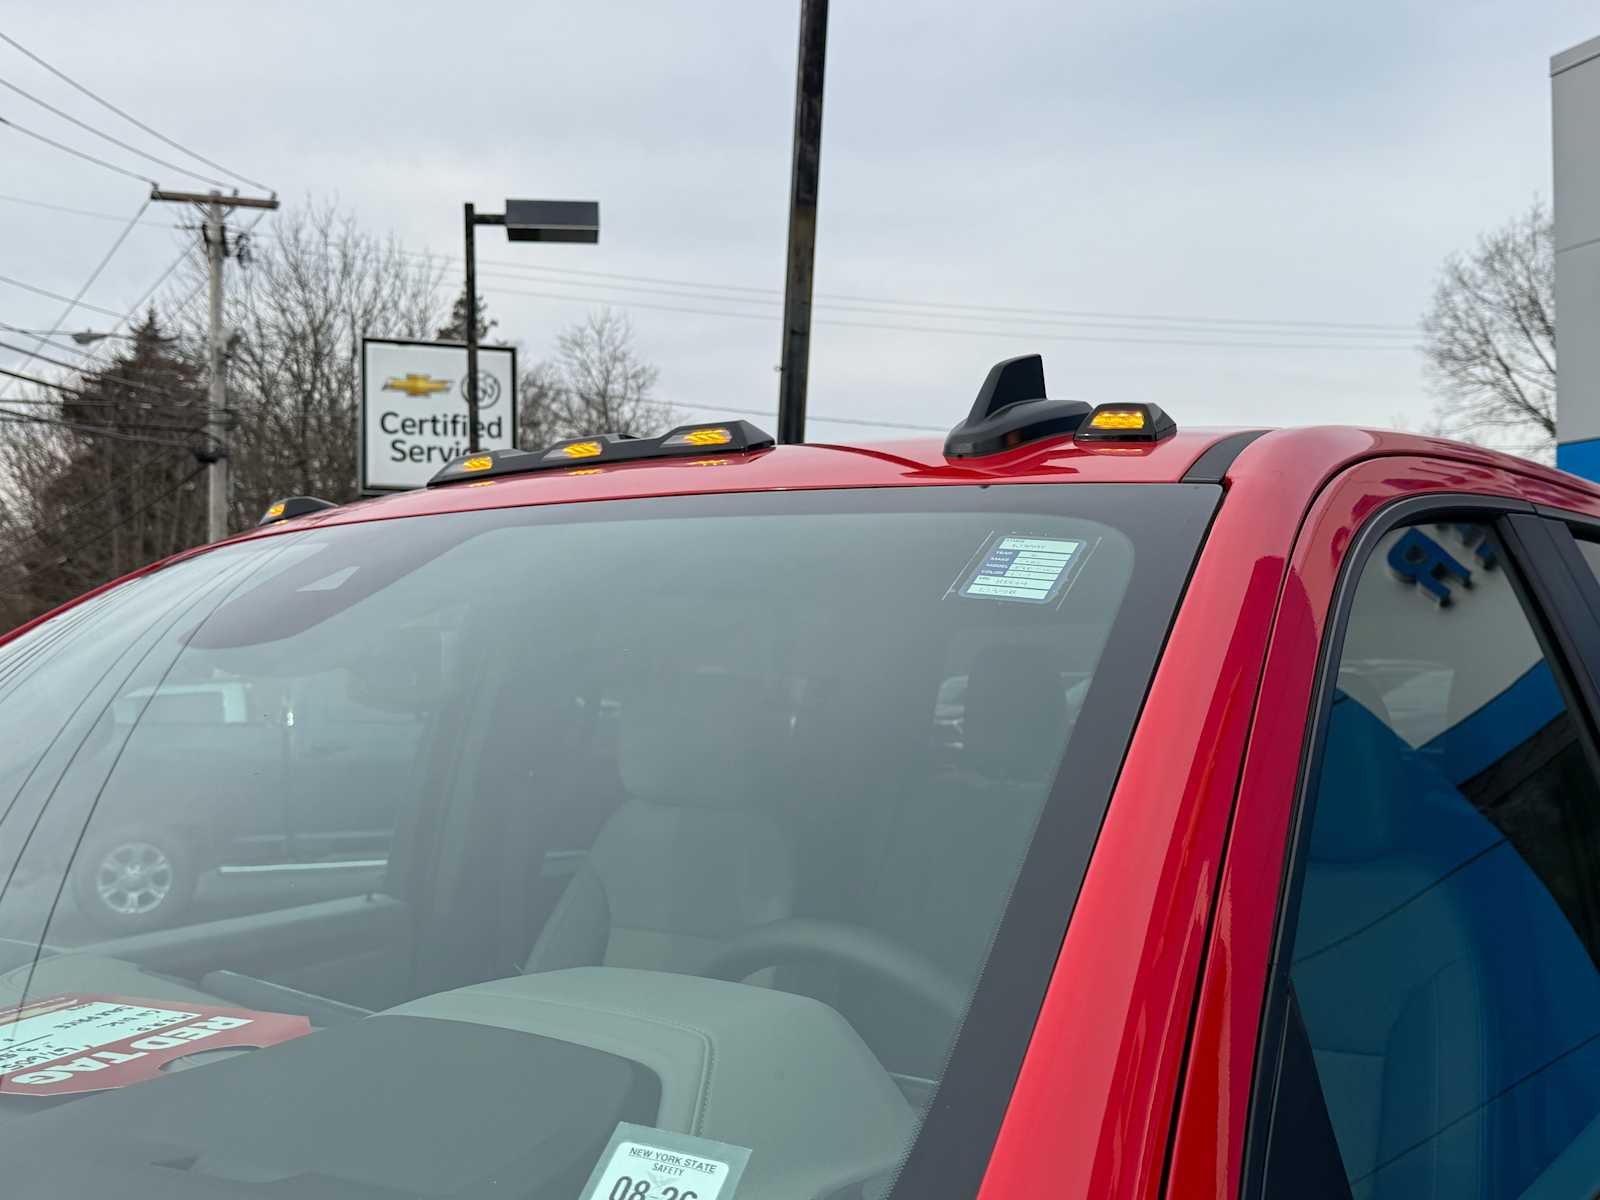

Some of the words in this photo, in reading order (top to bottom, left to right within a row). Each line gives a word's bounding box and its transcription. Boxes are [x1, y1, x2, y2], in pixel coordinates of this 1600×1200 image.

[390, 439, 491, 463] Servi
[131, 1016, 254, 1050] RED
[10, 1051, 149, 1084] TAG
[629, 1147, 653, 1158] NEW
[655, 1151, 682, 1165] YORK
[683, 1158, 718, 1174] STATE
[652, 1163, 685, 1176] SAFETY
[609, 1175, 698, 1200] 08-
